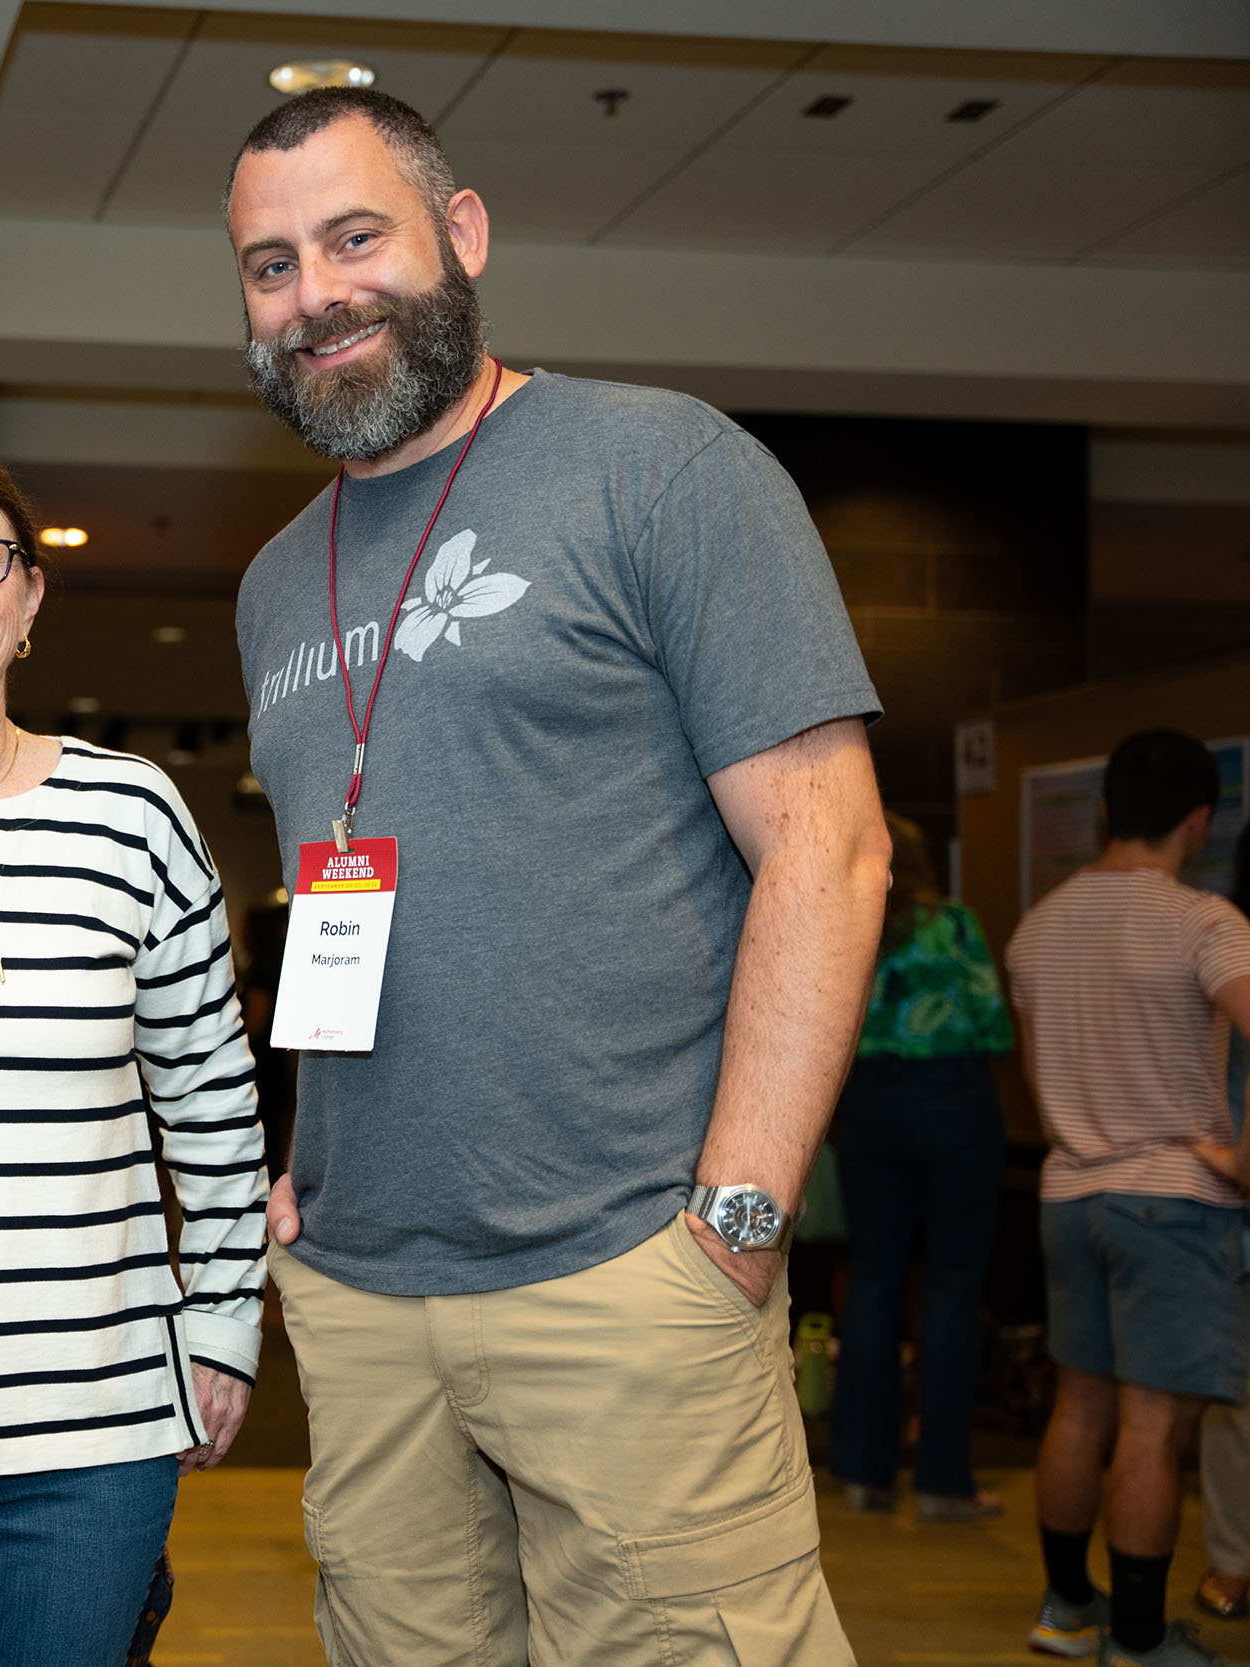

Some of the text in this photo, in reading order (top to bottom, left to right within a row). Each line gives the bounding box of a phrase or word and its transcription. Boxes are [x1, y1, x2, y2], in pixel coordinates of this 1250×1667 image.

[327, 855, 370, 868] ALUMNI
[322, 867, 374, 880] WEEKEND
[320, 921, 360, 936] Robin
[311, 954, 360, 967] Marjoram
